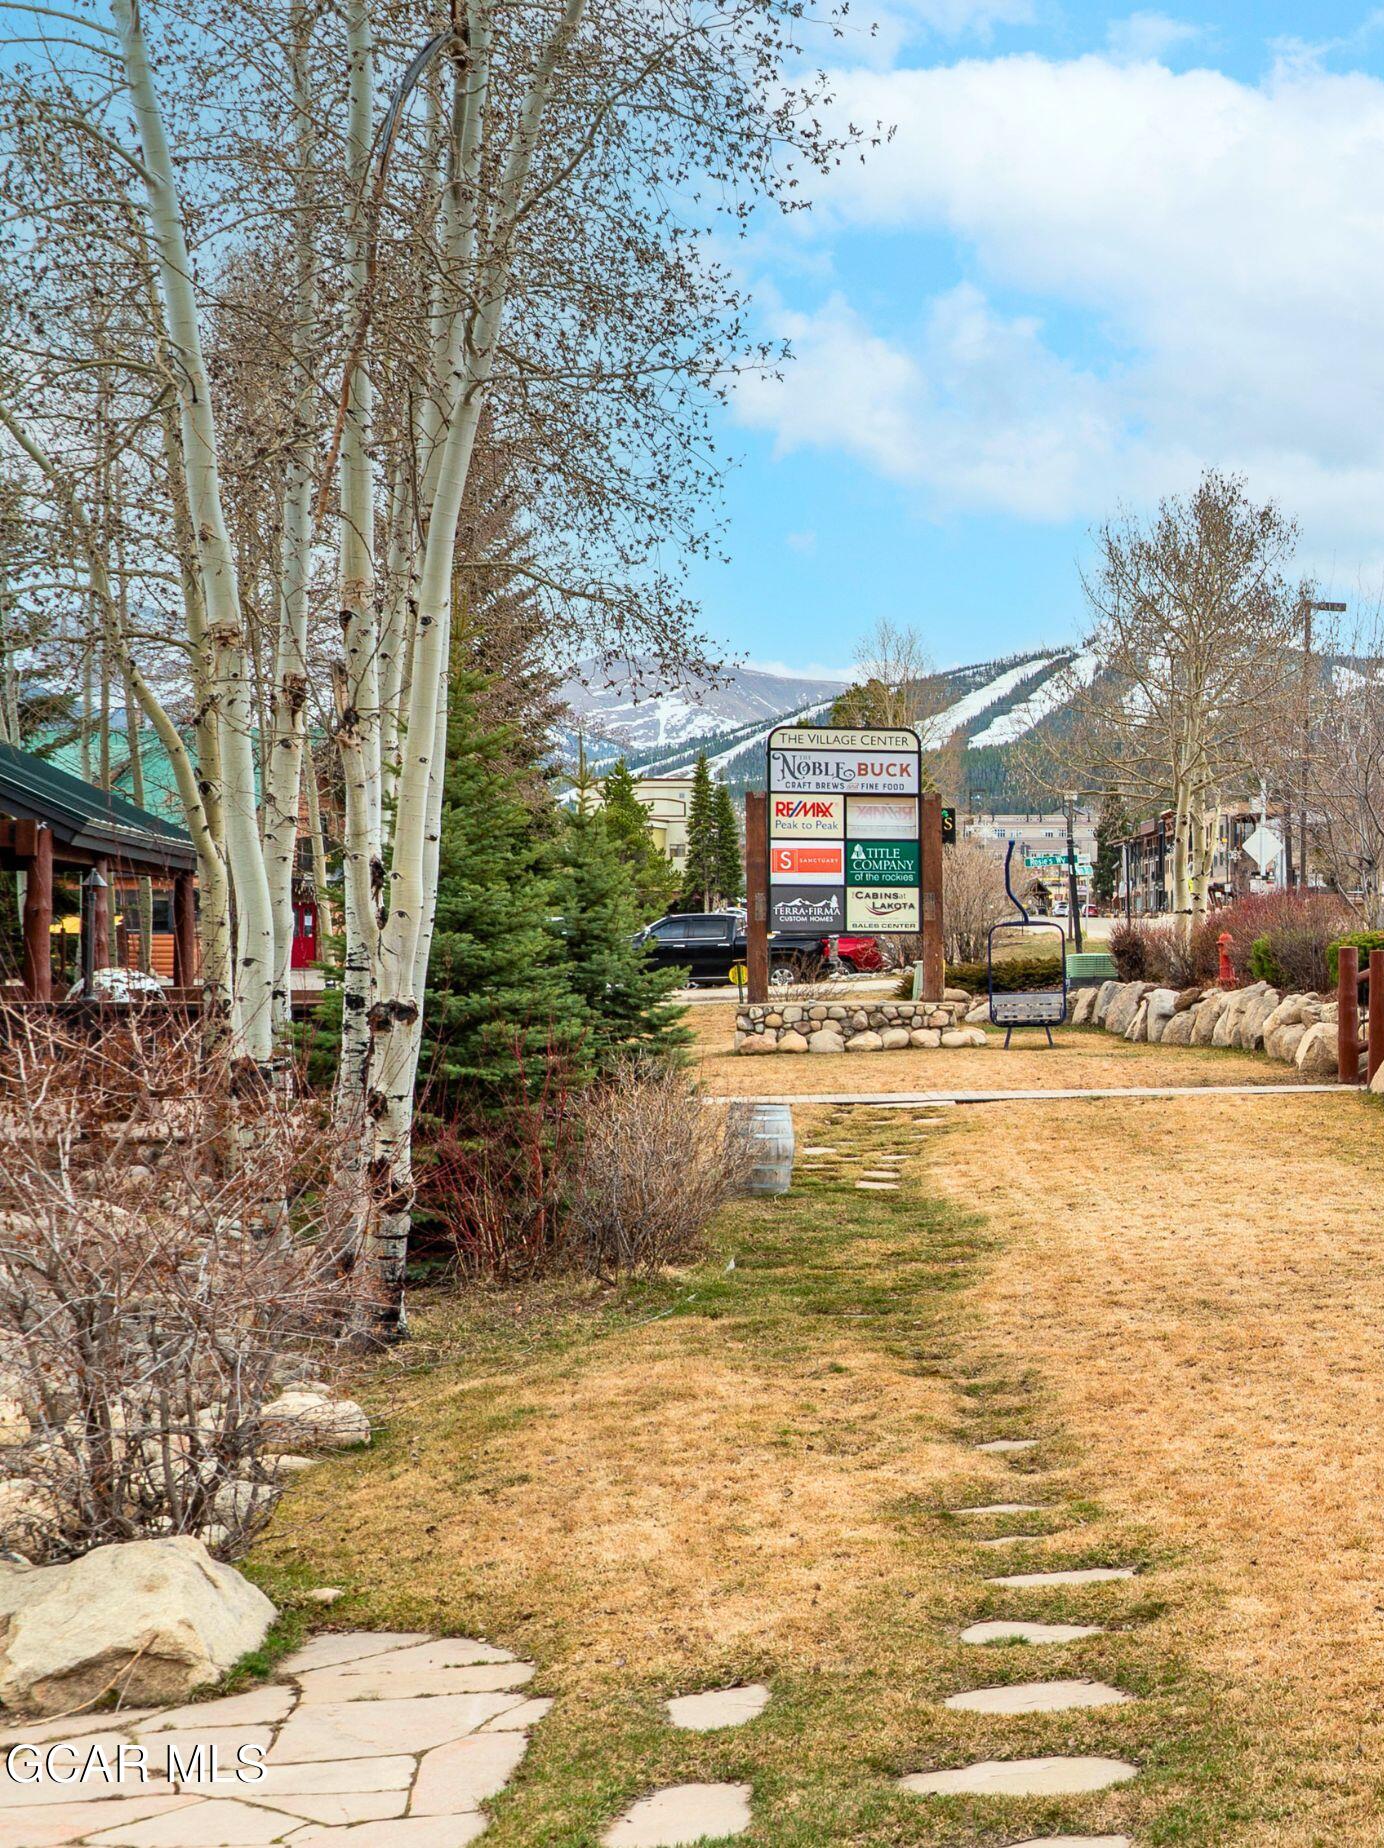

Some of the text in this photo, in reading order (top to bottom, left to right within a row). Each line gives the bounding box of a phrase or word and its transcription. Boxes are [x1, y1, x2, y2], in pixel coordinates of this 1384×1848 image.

[778, 733, 910, 747] THE VILLAGE CENTER
[772, 752, 913, 782] NOBLE BUCK
[784, 781, 812, 790] CRAFT
[815, 781, 845, 790] BREWS
[860, 782, 880, 791] FINE
[882, 783, 905, 791] FOOD
[775, 800, 834, 818] RE/MAX
[775, 819, 798, 830] Peak
[801, 822, 813, 830] to
[815, 820, 839, 831] Peak
[944, 817, 954, 831] S
[866, 847, 901, 859] TITLE
[780, 851, 792, 870] S
[852, 859, 914, 871] COMPANY
[854, 872, 914, 882] of the rockies
[854, 891, 899, 900] CABINS
[872, 901, 915, 910] LAKOTA
[809, 915, 834, 923] HOMES
